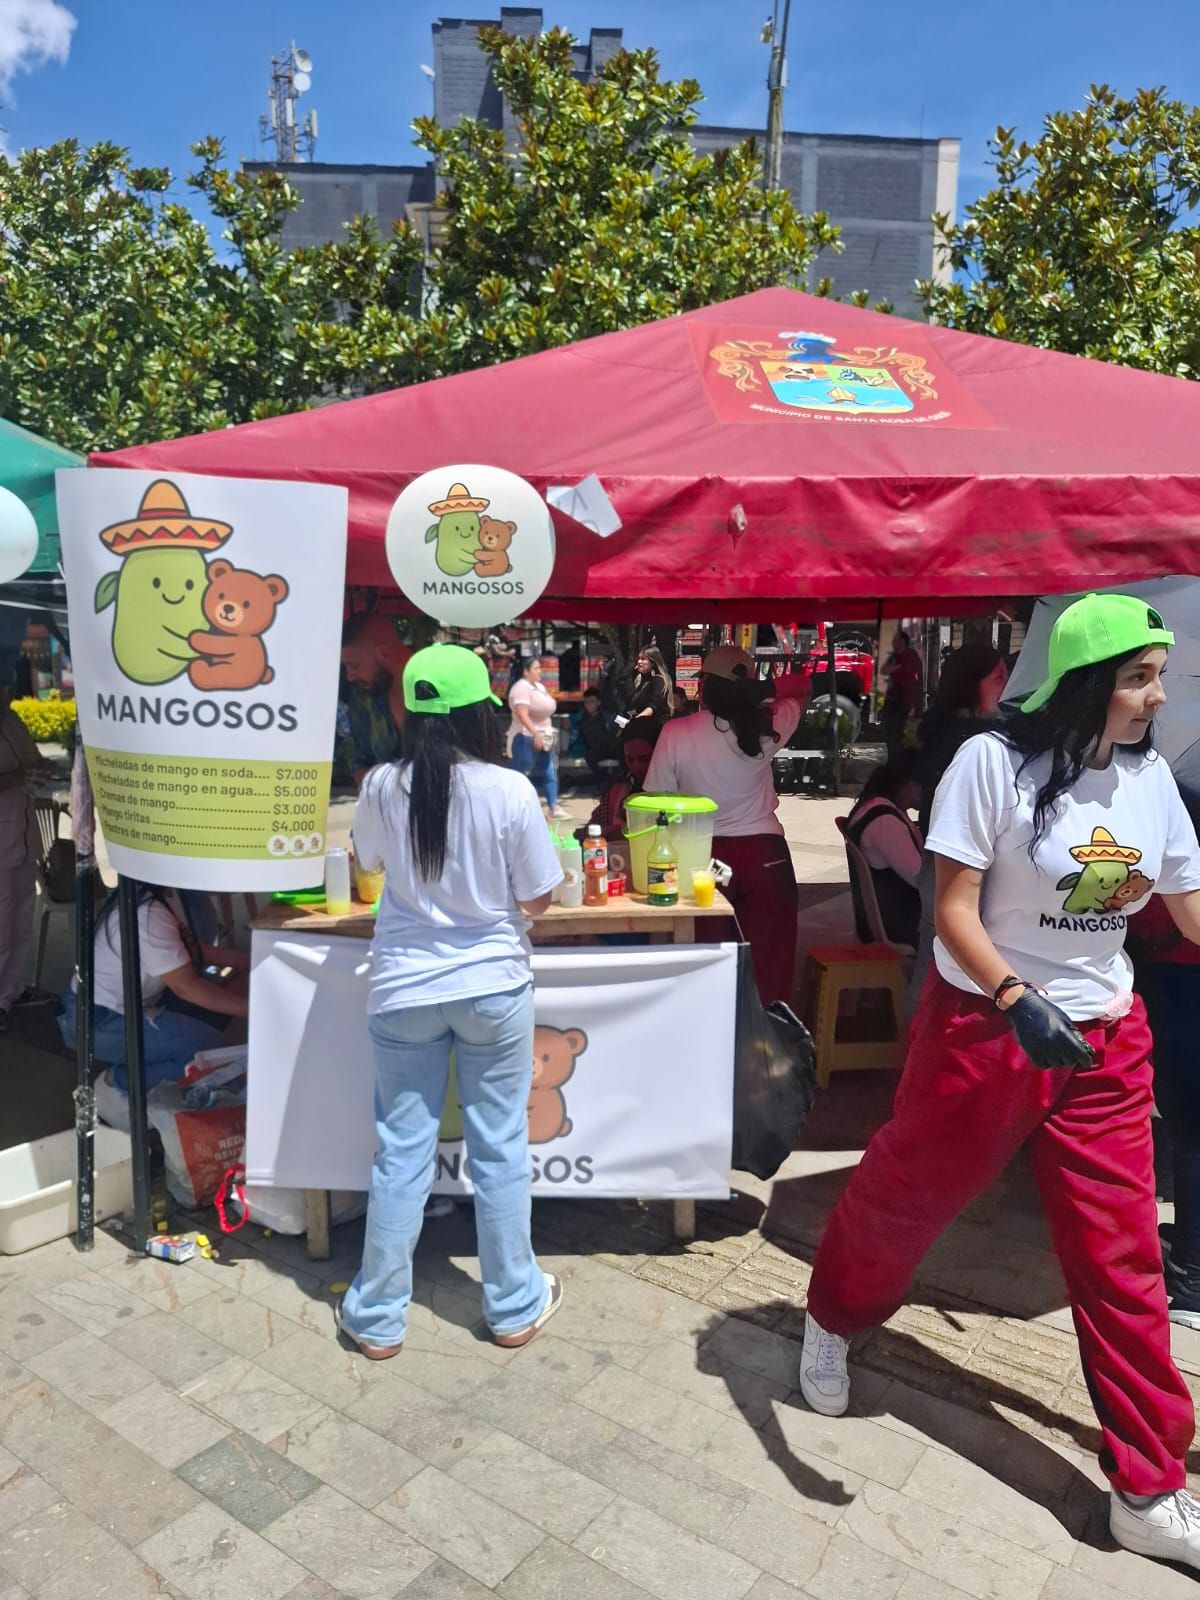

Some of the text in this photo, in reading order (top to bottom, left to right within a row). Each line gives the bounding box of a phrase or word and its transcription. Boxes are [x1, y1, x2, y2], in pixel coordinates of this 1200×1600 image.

[423, 581, 524, 595] MANGOSOS
[97, 693, 298, 731] MANGOSOS
[94, 755, 139, 772] Micheladas
[141, 762, 154, 773] de
[156, 766, 199, 777] mango
[202, 768, 218, 777] en
[276, 768, 318, 781] $7.000
[97, 771, 140, 789] Micheladas
[142, 778, 155, 790] de
[157, 783, 198, 795] mango
[201, 785, 217, 794] en
[274, 785, 317, 799] $5.000
[99, 787, 126, 803] Cremas
[127, 794, 138, 805] de
[273, 803, 316, 816] $3.000
[124, 810, 150, 824] tiritas
[271, 820, 315, 834] $4.000
[130, 829, 141, 839] de
[1040, 913, 1125, 931] MANGOSO
